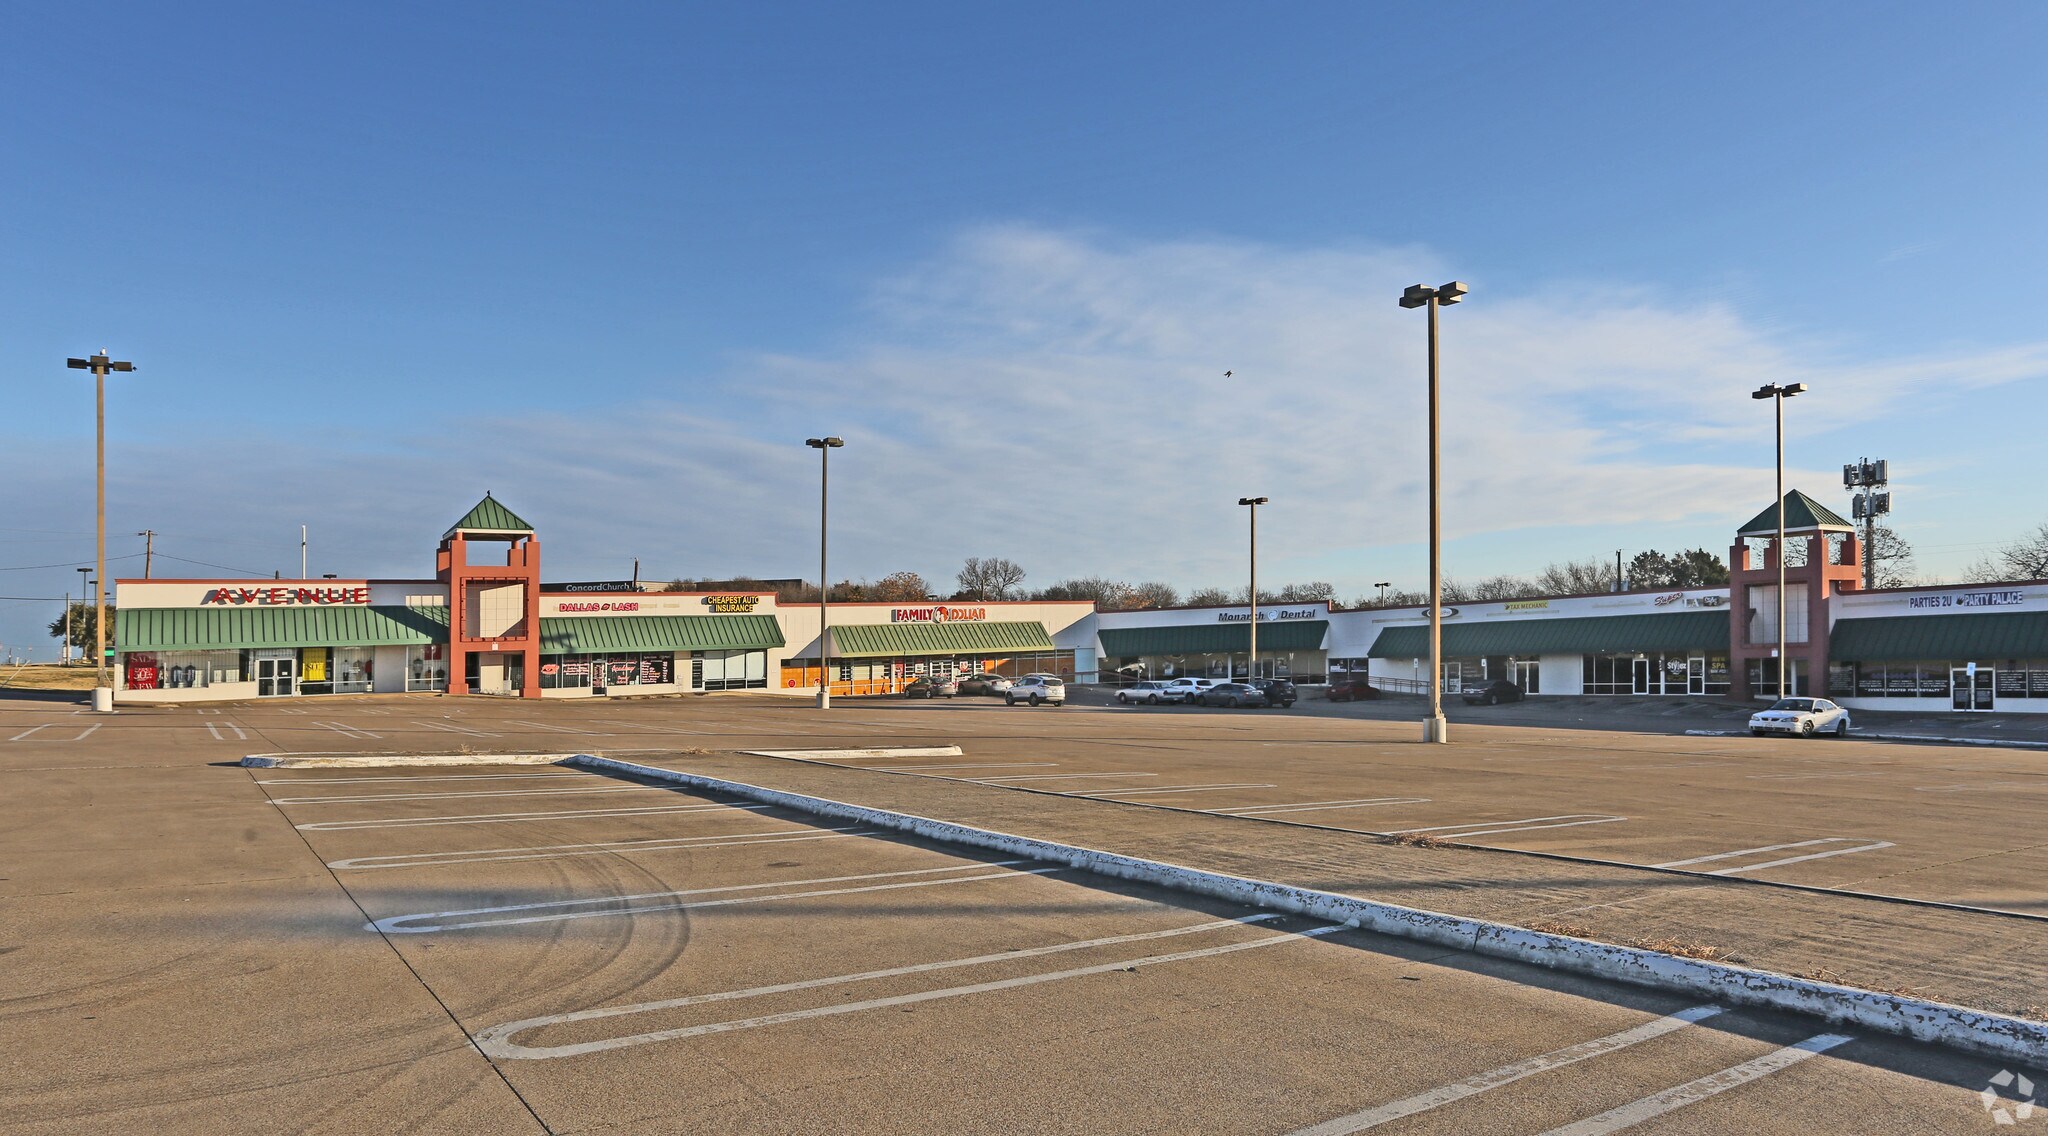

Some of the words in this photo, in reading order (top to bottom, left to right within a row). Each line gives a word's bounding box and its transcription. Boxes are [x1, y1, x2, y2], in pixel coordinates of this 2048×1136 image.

[211, 587, 372, 604] AVENUE
[707, 596, 741, 605] CHEAPEST
[743, 596, 759, 605] AUTO
[1655, 591, 1684, 606] Super
[1964, 594, 1991, 607] PARTY
[1991, 591, 2023, 605] PALACE
[559, 603, 600, 612] DALLAS
[612, 603, 639, 612] LASH
[715, 604, 754, 612] INSURANCE
[1521, 601, 1548, 609] MECHANIC
[1909, 596, 1940, 609] PARTIES
[1942, 596, 1952, 607] 2U
[896, 608, 934, 621] FAMILY
[951, 607, 986, 620] DOLLAR
[1218, 612, 1265, 621] Monarh
[1280, 609, 1316, 619] Dental
